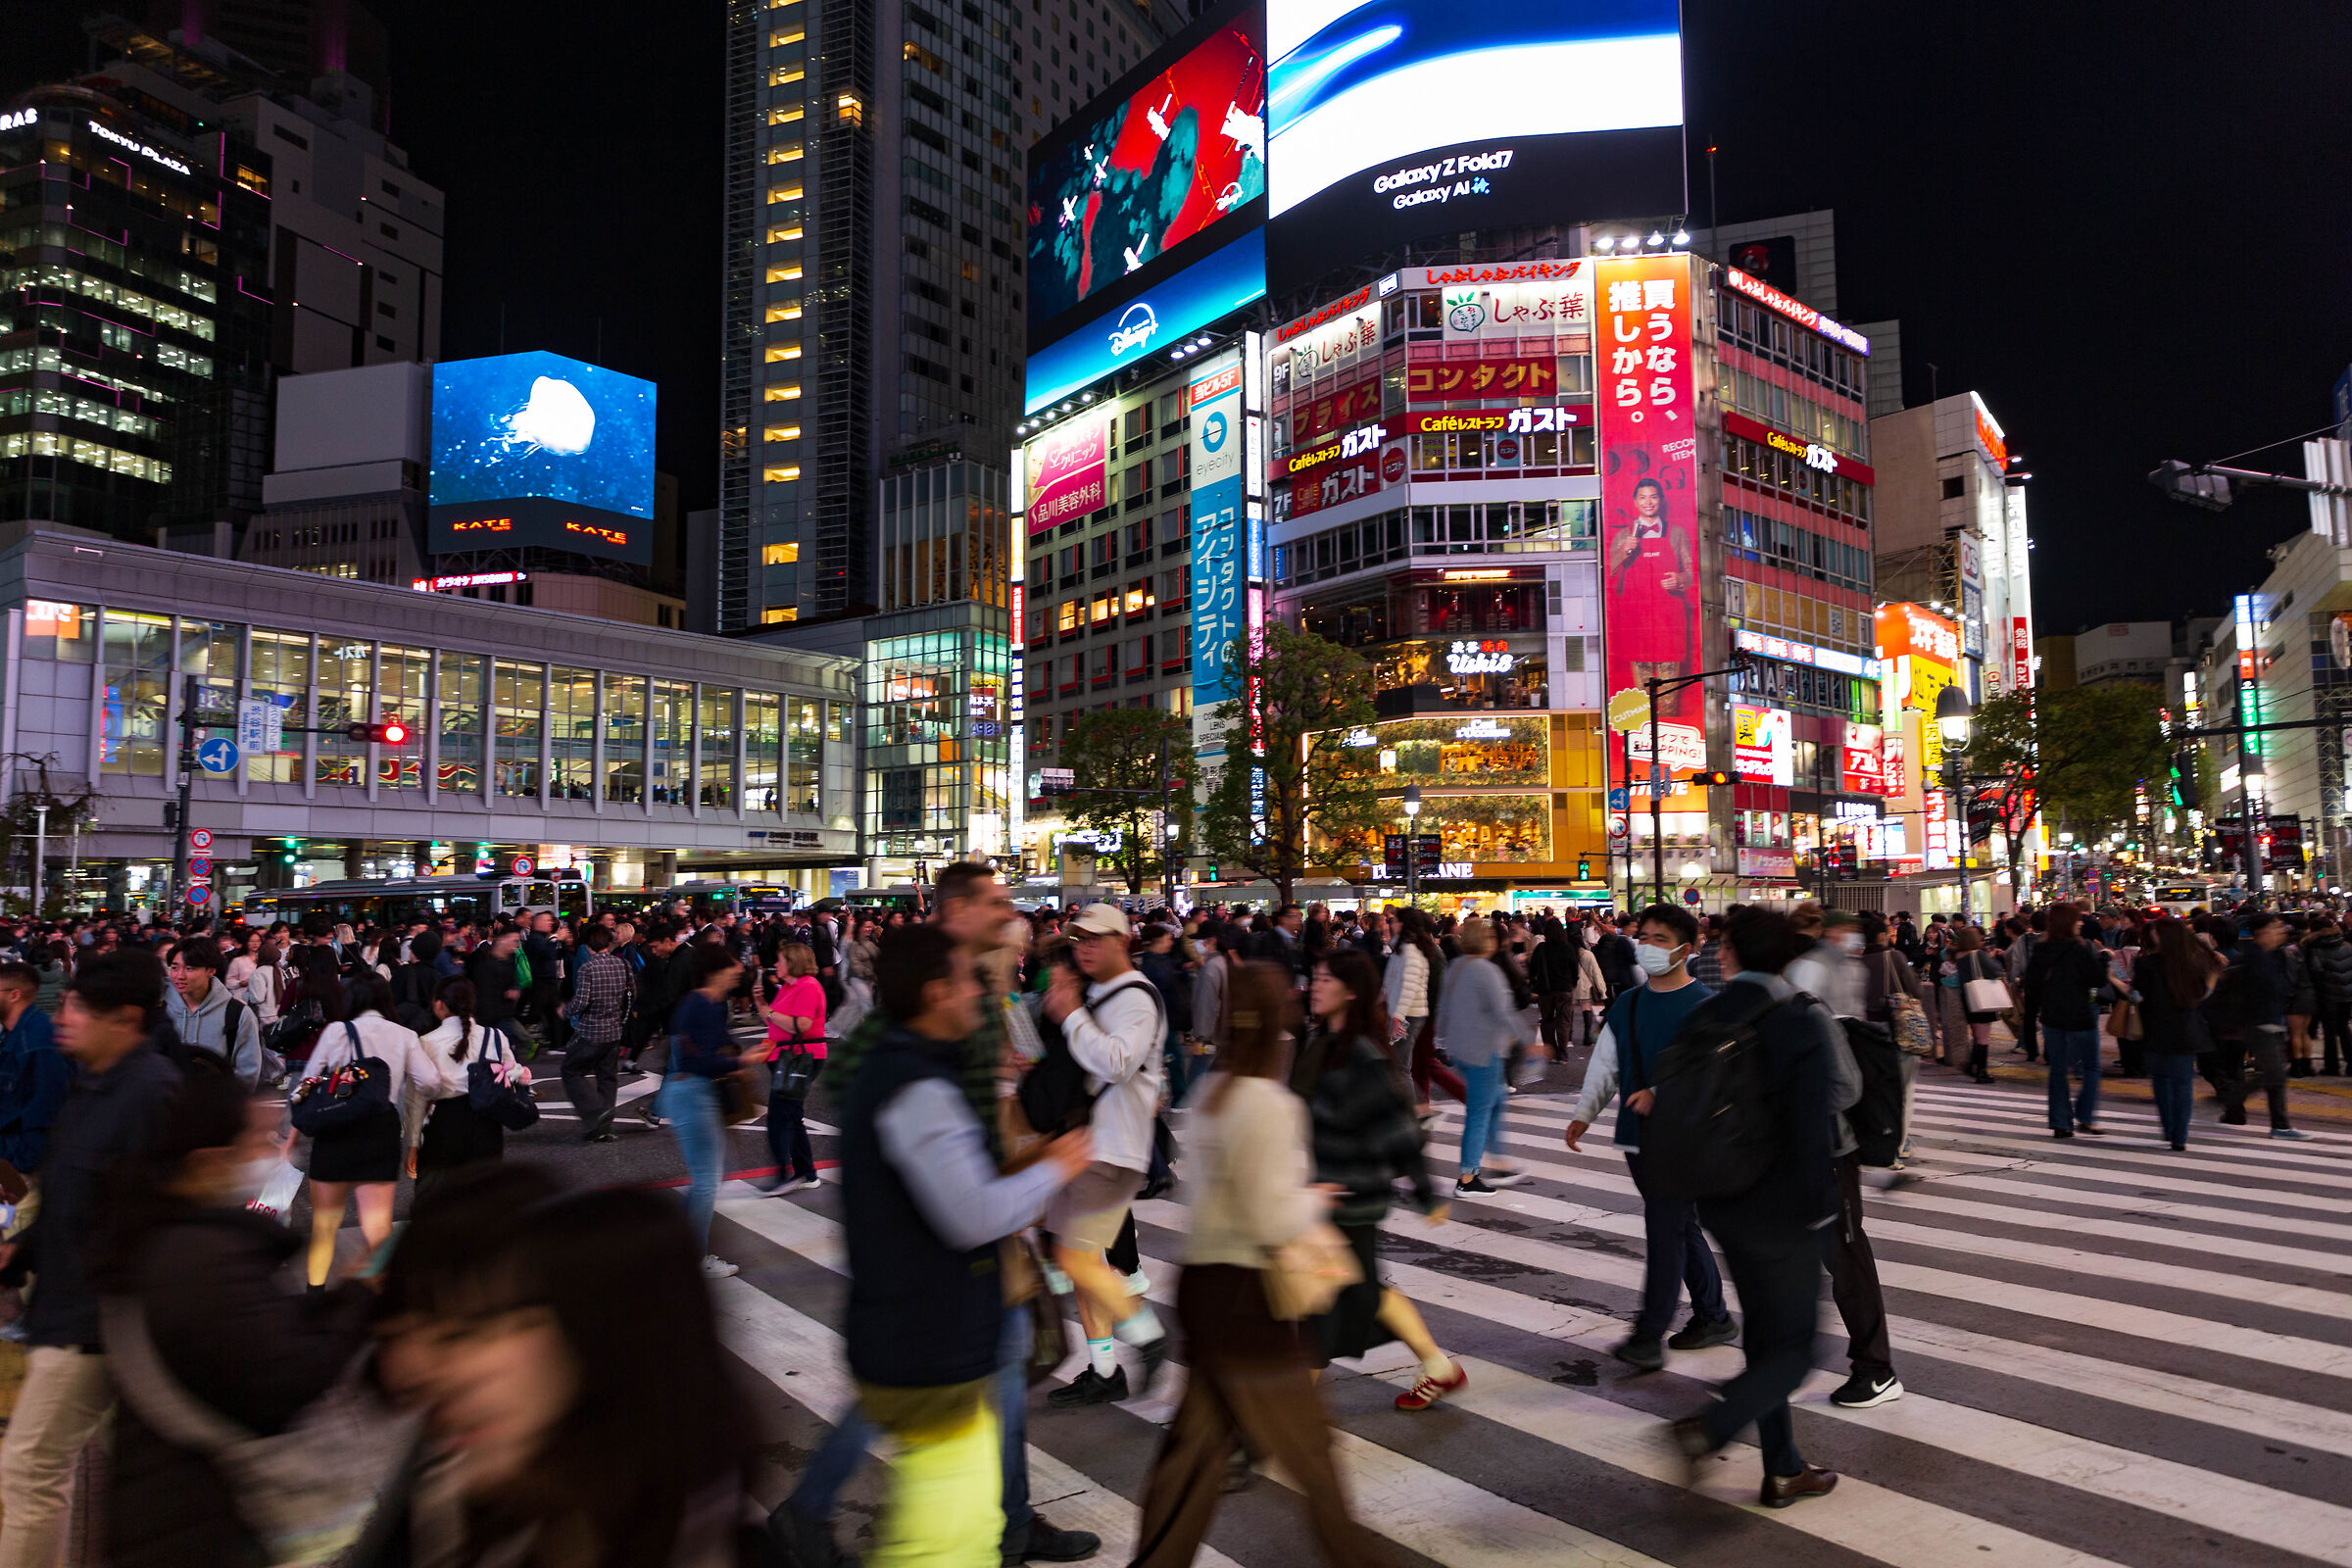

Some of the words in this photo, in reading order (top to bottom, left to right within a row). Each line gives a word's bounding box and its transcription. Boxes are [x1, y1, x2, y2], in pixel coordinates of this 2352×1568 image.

[88, 120, 140, 152] TOKYU
[141, 146, 190, 175] PLAZA
[1373, 164, 1442, 193] Galaxy
[1442, 158, 1456, 176] Z
[1457, 150, 1513, 173] Fold7
[1393, 185, 1451, 209] Galaxy
[1452, 180, 1470, 197] AI
[1427, 261, 1582, 285] しゃぶしゃぶバイキング
[1277, 285, 1371, 342] しゃぶしゃぶバイキング
[1494, 292, 1585, 324] しゃぶ葉
[1322, 319, 1376, 363] しゃぶ葉
[1608, 280, 1644, 423] 推しから。
[1642, 279, 1679, 421] 買うなら、
[1195, 369, 1236, 401] 当ビル5F
[1274, 362, 1290, 382] 9F
[1409, 362, 1551, 392] コンタクト
[1294, 381, 1380, 436] プライス
[1508, 407, 1578, 433] ガスト
[1060, 443, 1098, 470] クリニック
[1342, 423, 1387, 459] ガスト
[1197, 452, 1235, 476] eyecity
[1806, 443, 1838, 473] ガスト
[1038, 480, 1102, 523] 品川美容外科
[1321, 465, 1376, 509] ガスト
[1274, 492, 1293, 515] 7F
[453, 518, 512, 530] KATE
[565, 522, 627, 540] KATE
[1197, 513, 1218, 667] アイシティ
[1221, 507, 1237, 663] コンタクトの
